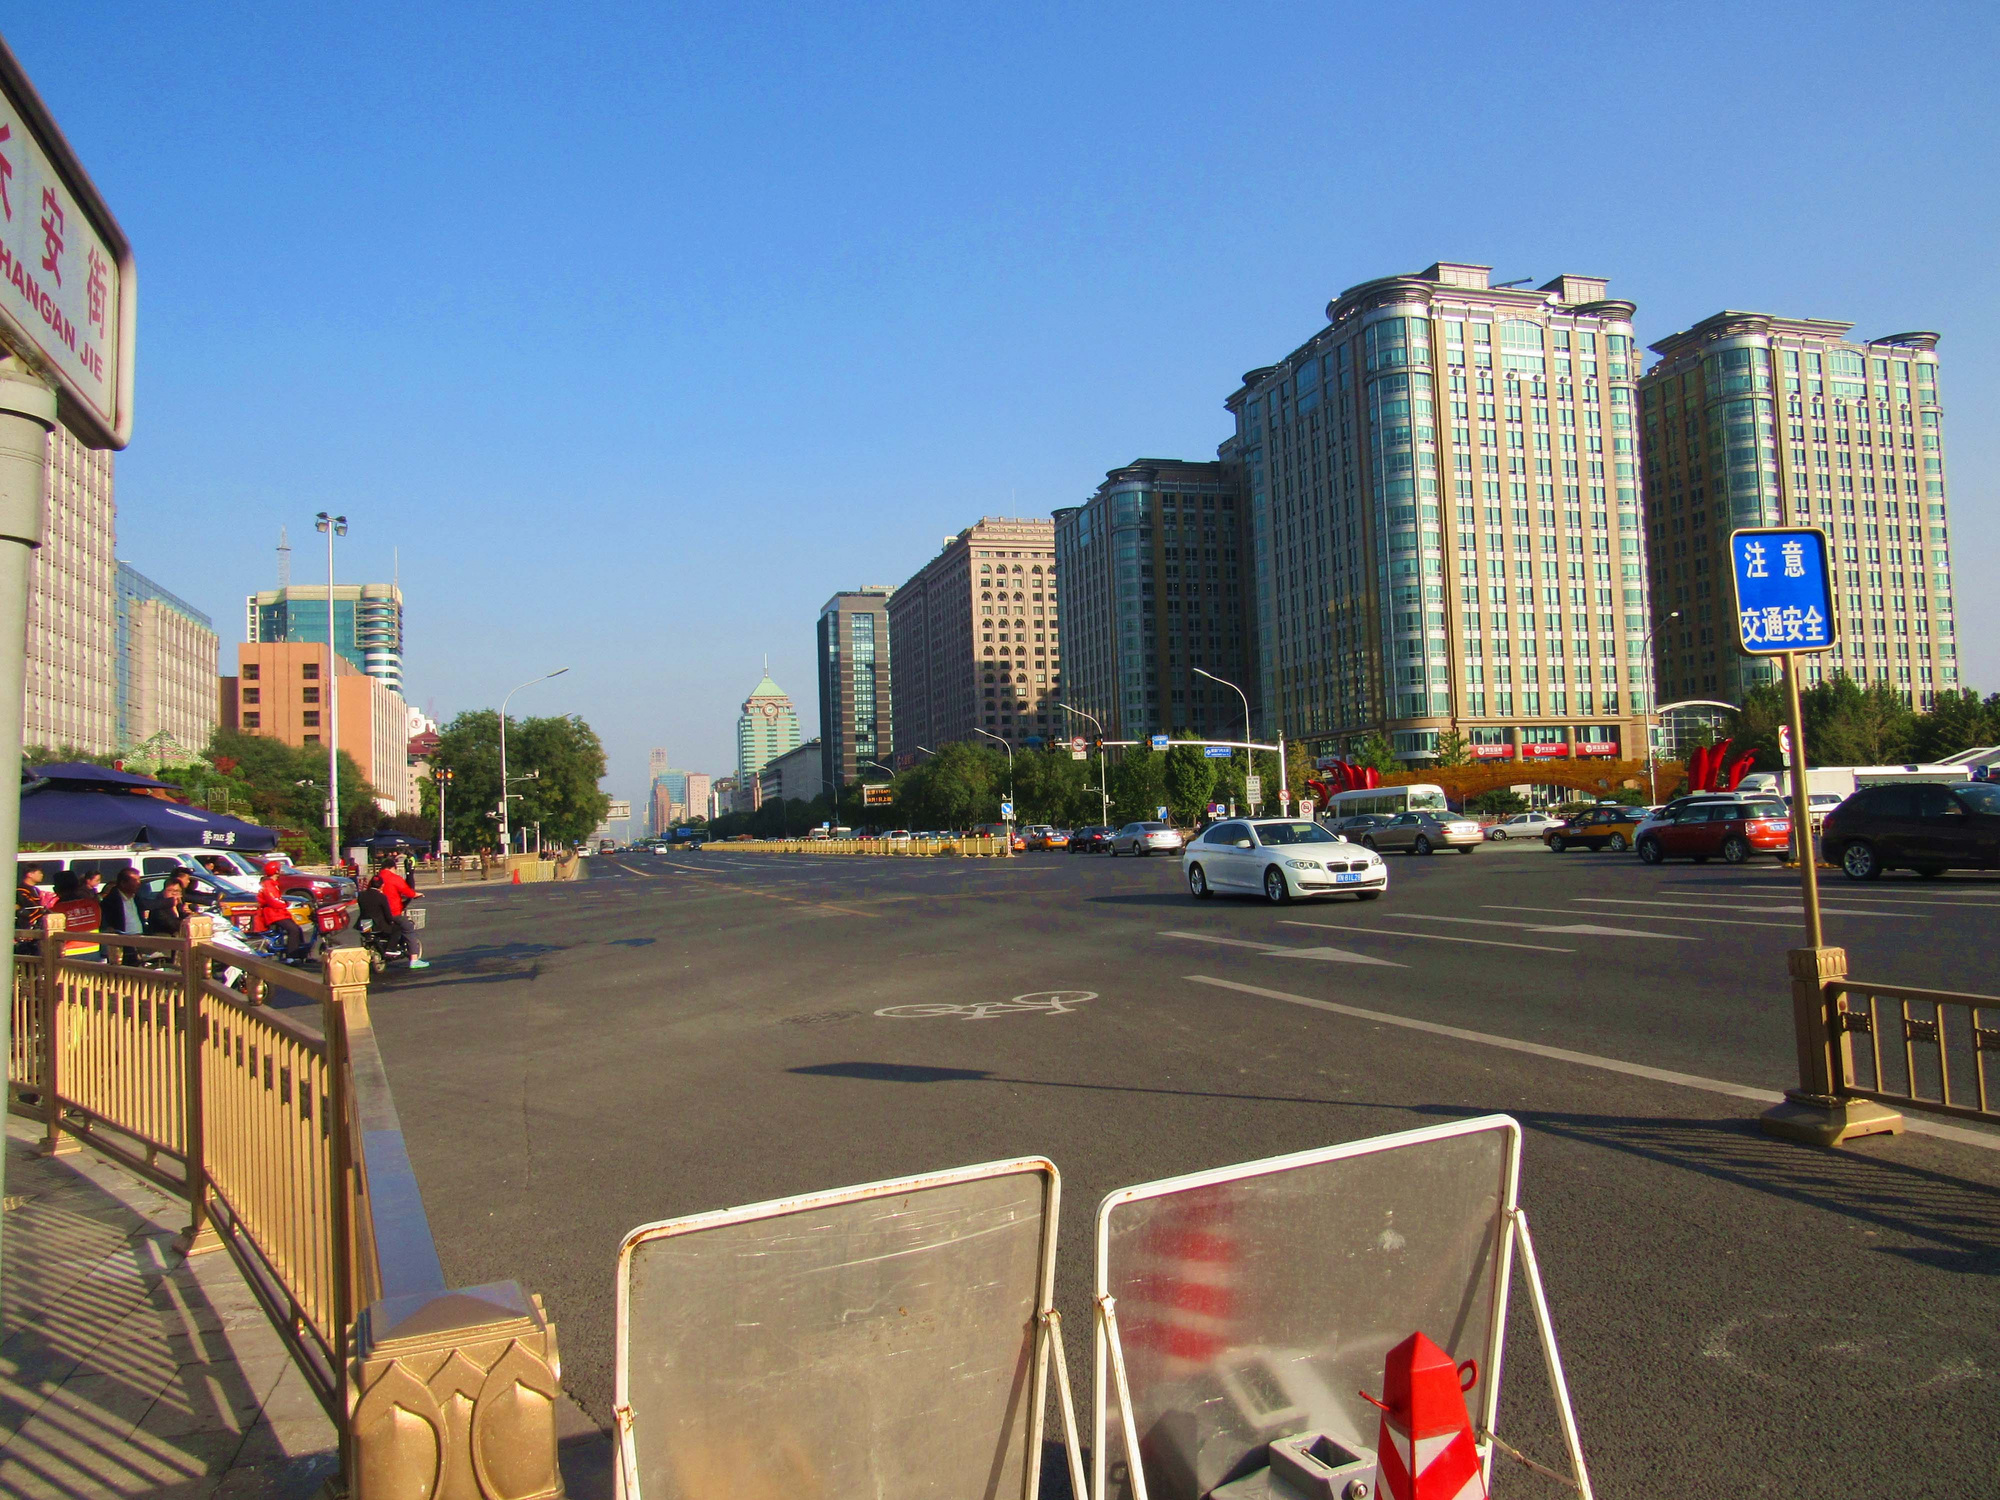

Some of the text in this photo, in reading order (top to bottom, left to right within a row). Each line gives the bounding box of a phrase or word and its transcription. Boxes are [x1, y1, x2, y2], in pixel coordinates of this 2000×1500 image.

[80, 341, 103, 384] JIE
[1744, 540, 1806, 578] 注意
[1741, 605, 1824, 644] 交通安全
